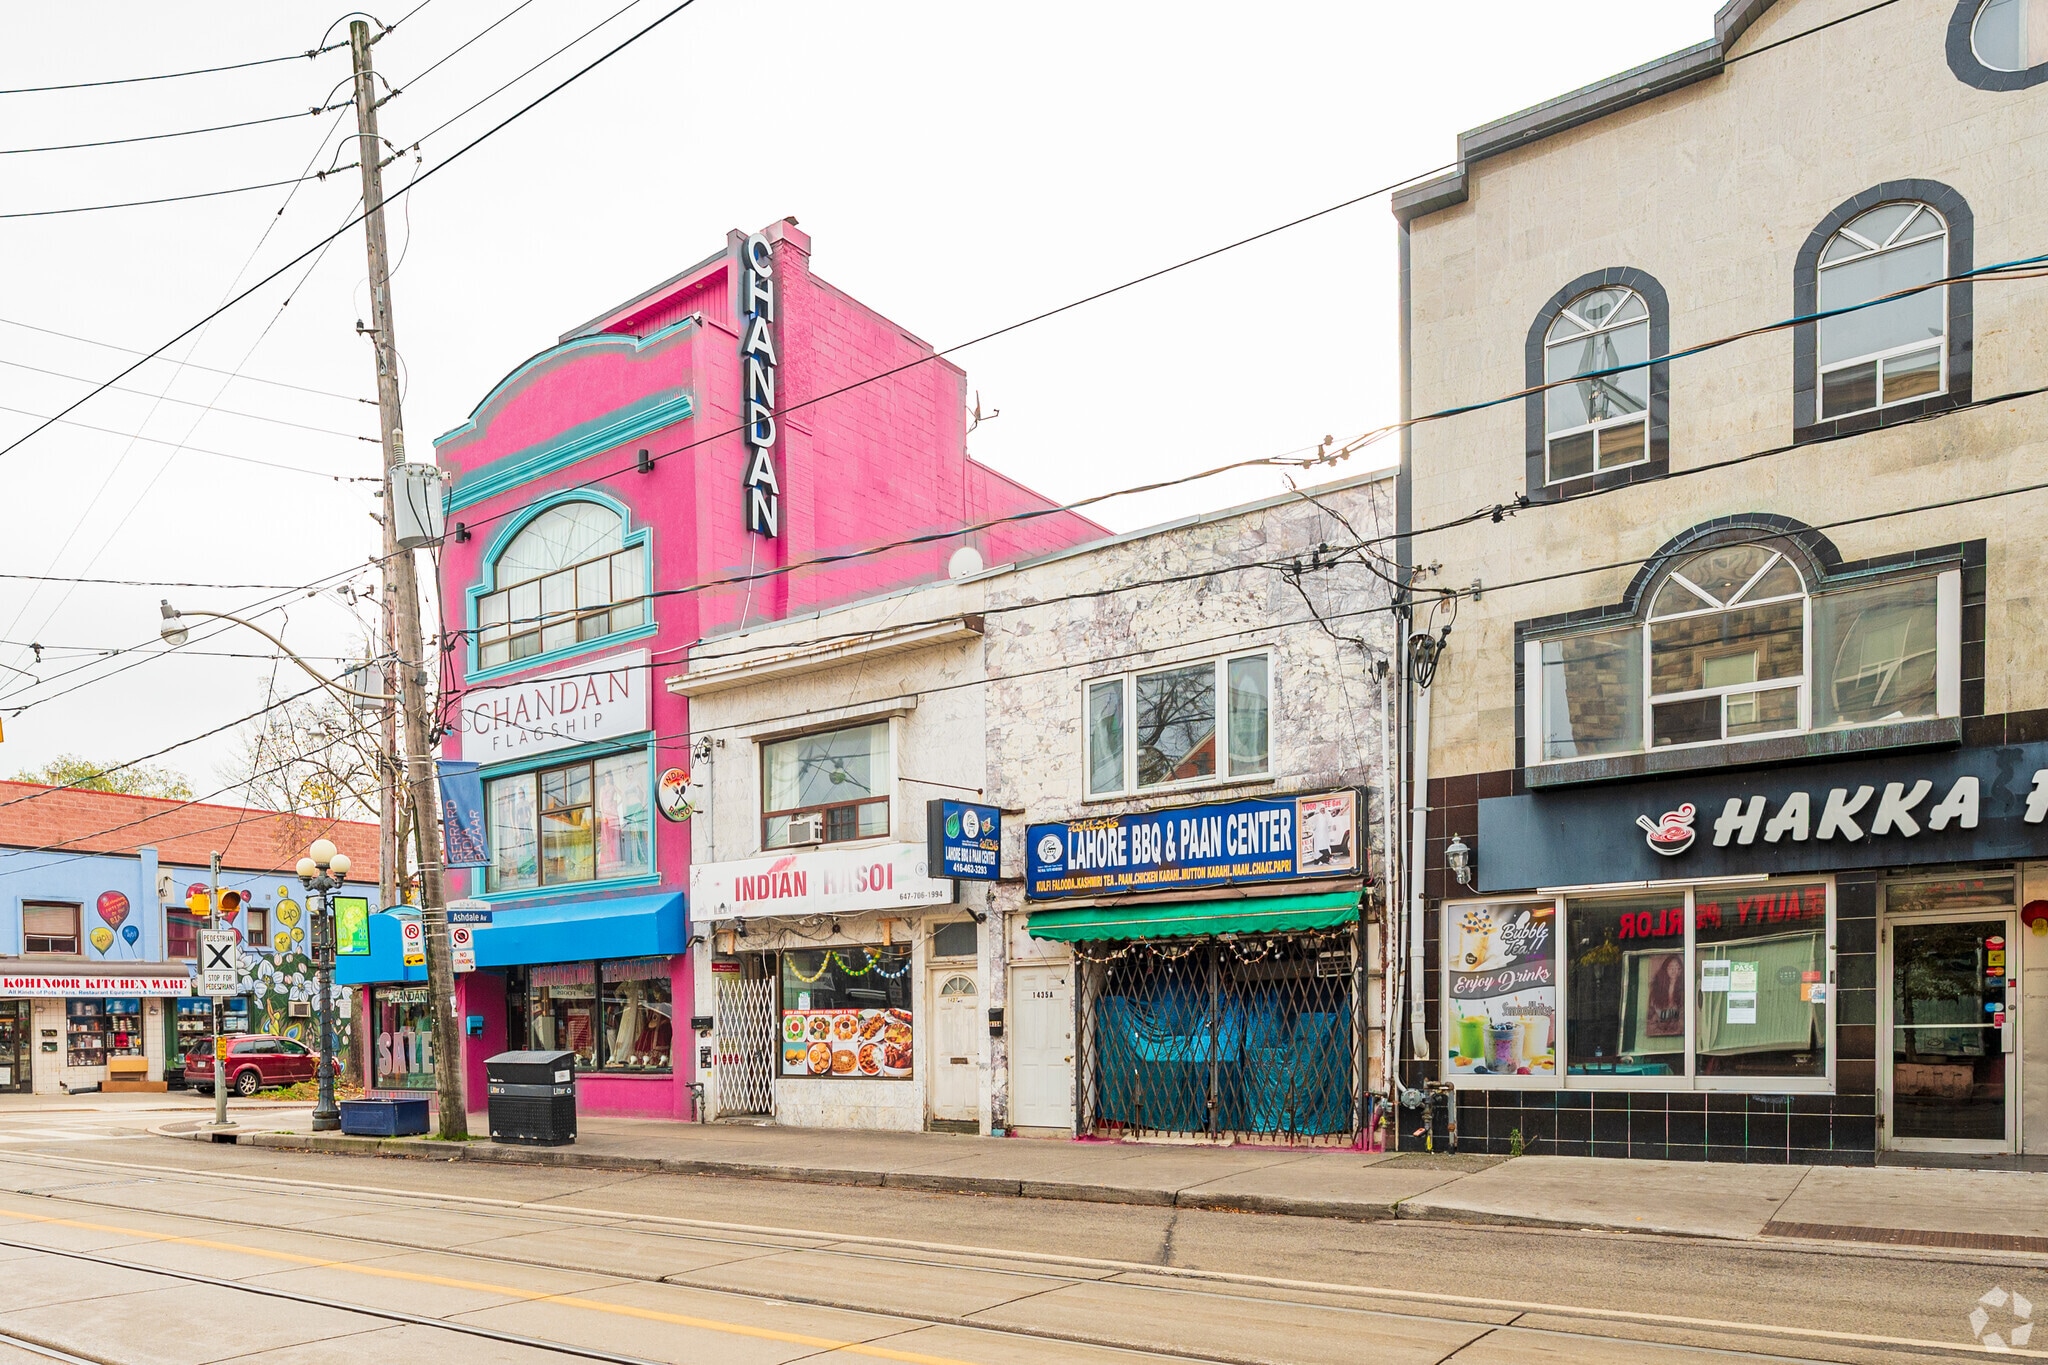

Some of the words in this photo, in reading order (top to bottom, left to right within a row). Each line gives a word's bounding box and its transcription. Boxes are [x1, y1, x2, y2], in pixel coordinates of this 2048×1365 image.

[746, 232, 780, 539] CHANDAN
[473, 665, 630, 735] CHANDAN
[492, 712, 603, 751] FLAGSHIP
[663, 772, 691, 787] INDIAN
[668, 804, 693, 818] RASOI
[1712, 775, 1980, 847] HAKKA
[445, 799, 463, 864] GERRARD
[460, 827, 476, 864] INDIA
[468, 808, 488, 863] BAZAAR
[1067, 826, 1128, 870] LAHORE
[1132, 822, 1162, 865] BBQ
[1165, 820, 1177, 862] &
[1180, 815, 1222, 860] PAAN
[1226, 808, 1292, 857] CENTER
[735, 870, 807, 902] INDIAN
[453, 912, 480, 922] Ashdale
[1501, 921, 1549, 940] Bubble
[4, 978, 81, 988] KOHINOOR
[85, 979, 148, 989] KITCHEN
[151, 979, 187, 989] WARE
[1453, 975, 1495, 994] Enjoy
[1498, 966, 1552, 992] Drinks
[1734, 964, 1755, 972] PASS
[378, 1031, 434, 1075] SALE
